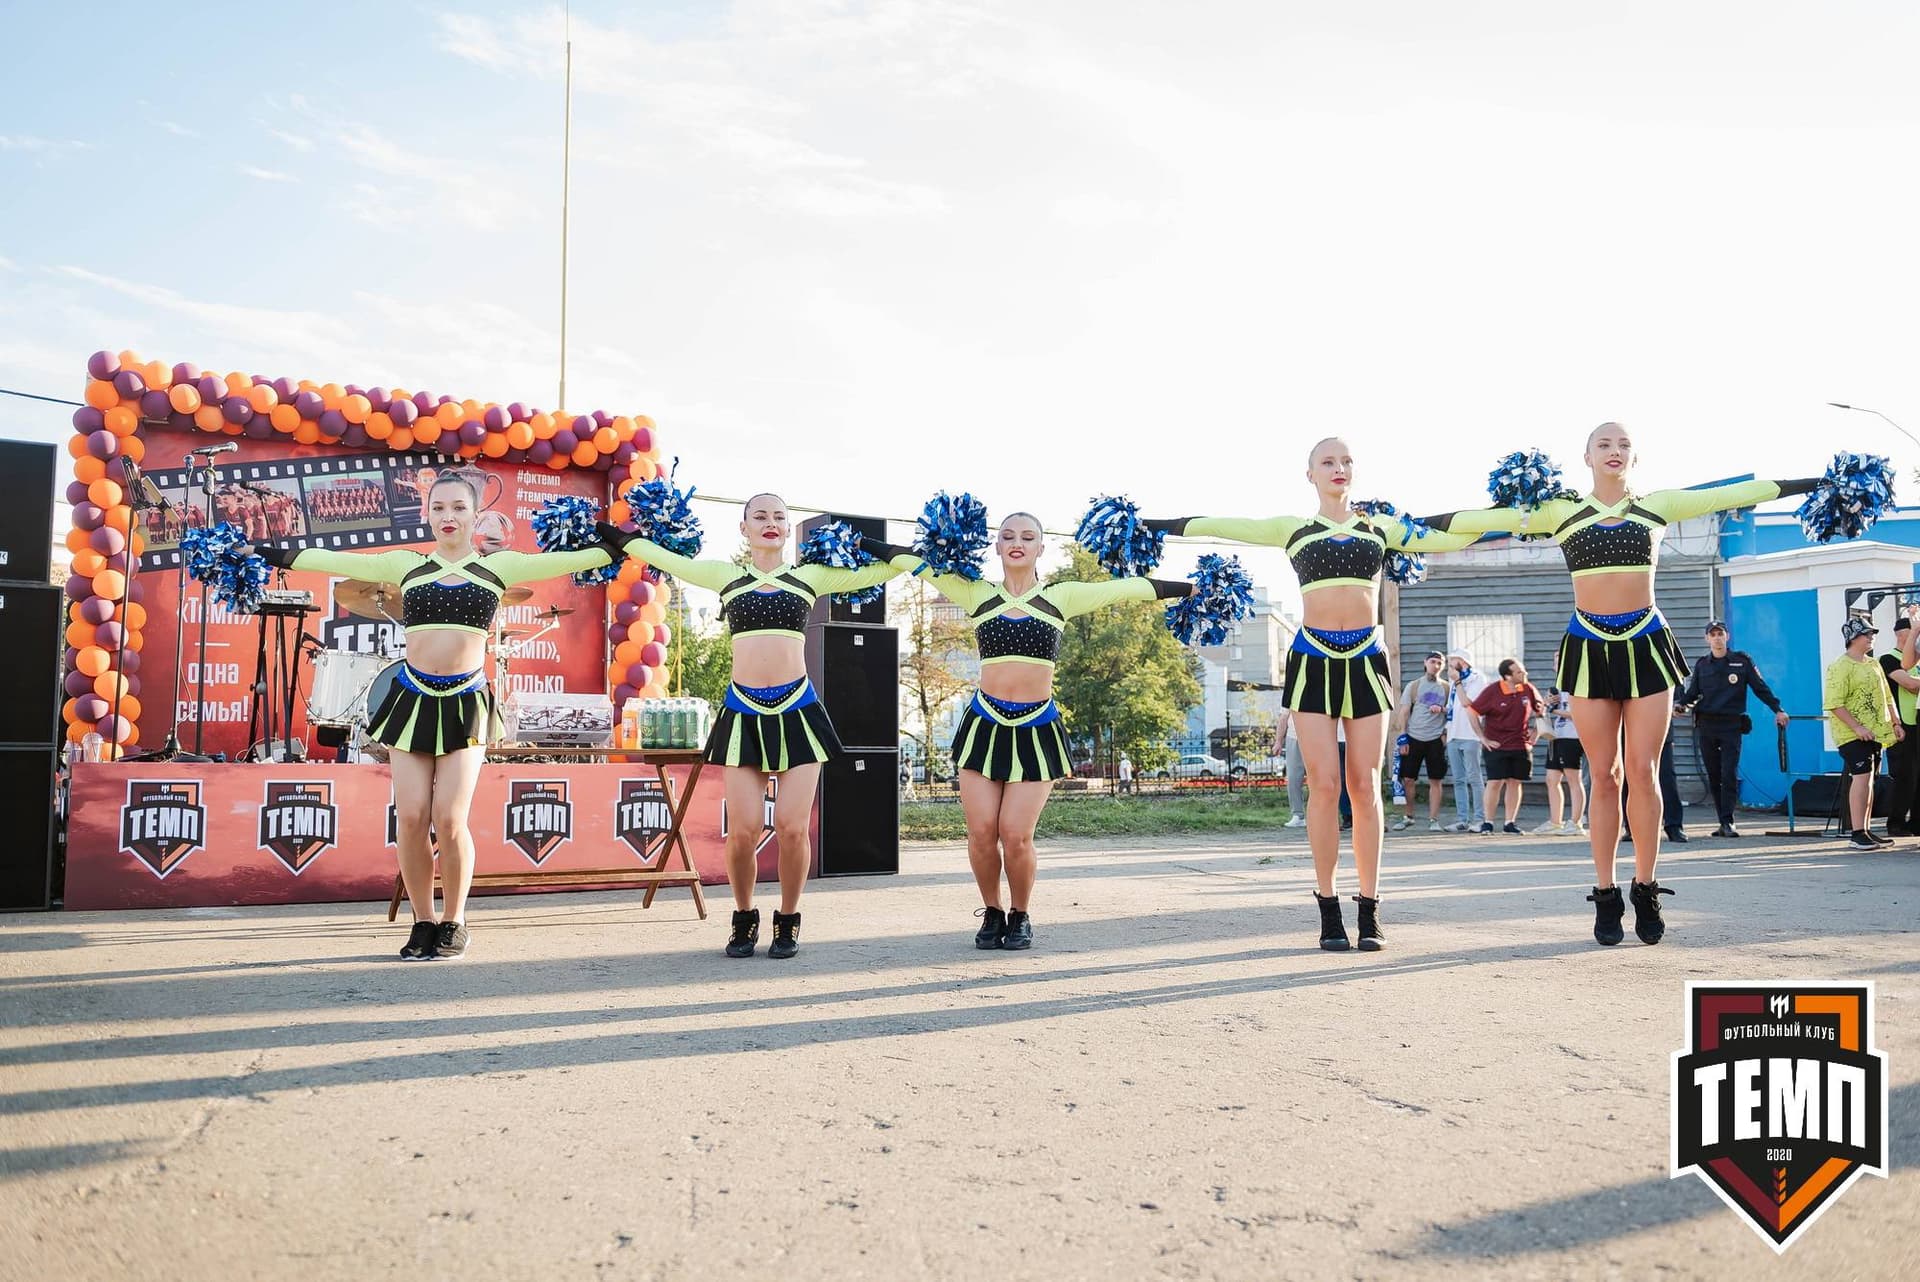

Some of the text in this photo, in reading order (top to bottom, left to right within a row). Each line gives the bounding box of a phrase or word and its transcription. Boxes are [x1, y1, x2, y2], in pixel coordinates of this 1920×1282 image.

[187, 662, 239, 687] одна
[176, 696, 249, 723] семья!
[129, 807, 199, 841] ТЕМП
[266, 806, 331, 839] ТЕМП
[511, 803, 567, 834] ТЕМП
[621, 801, 672, 831] ТЕМП
